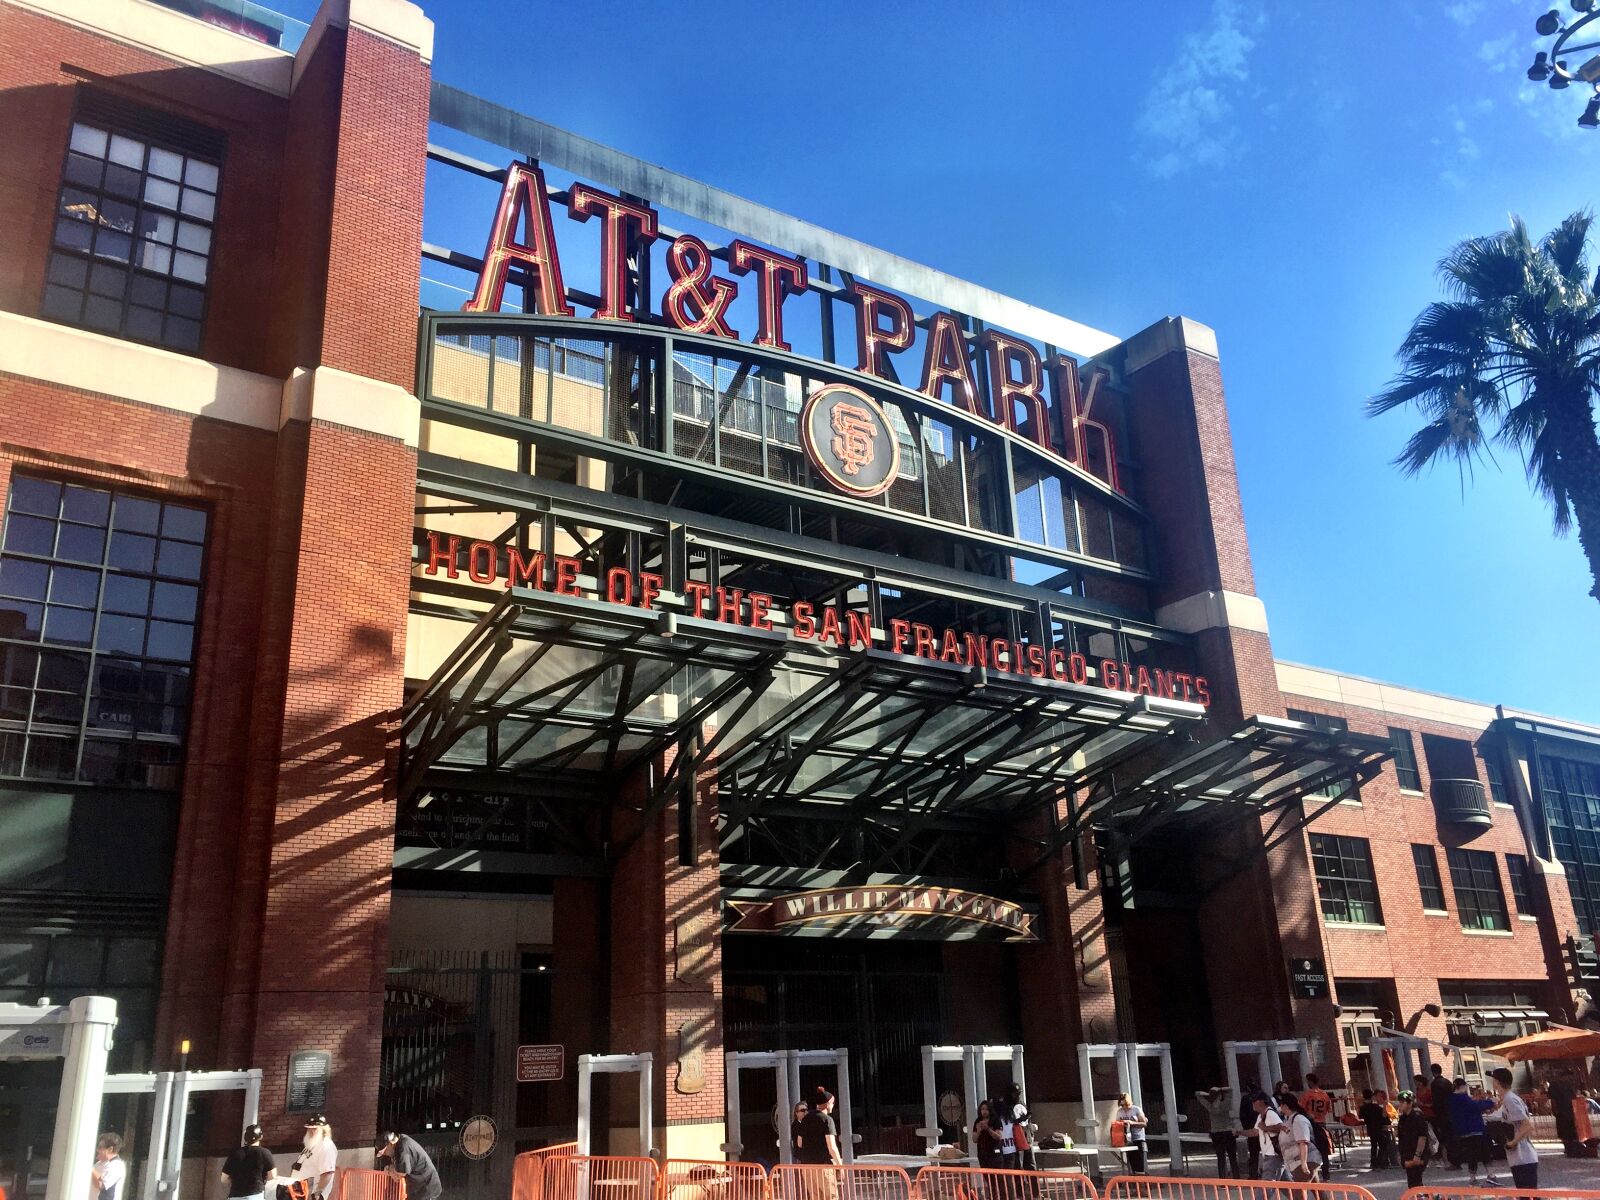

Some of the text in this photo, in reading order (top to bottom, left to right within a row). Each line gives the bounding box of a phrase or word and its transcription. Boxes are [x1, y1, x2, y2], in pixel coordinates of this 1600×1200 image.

[466, 160, 1126, 495] AT&T PARK
[425, 531, 1211, 707] HOME OF THE SAN FRANCISCO GIANTS
[786, 891, 1022, 926] WILLIE MAYS GATE
[1311, 1099, 1325, 1113] 12
